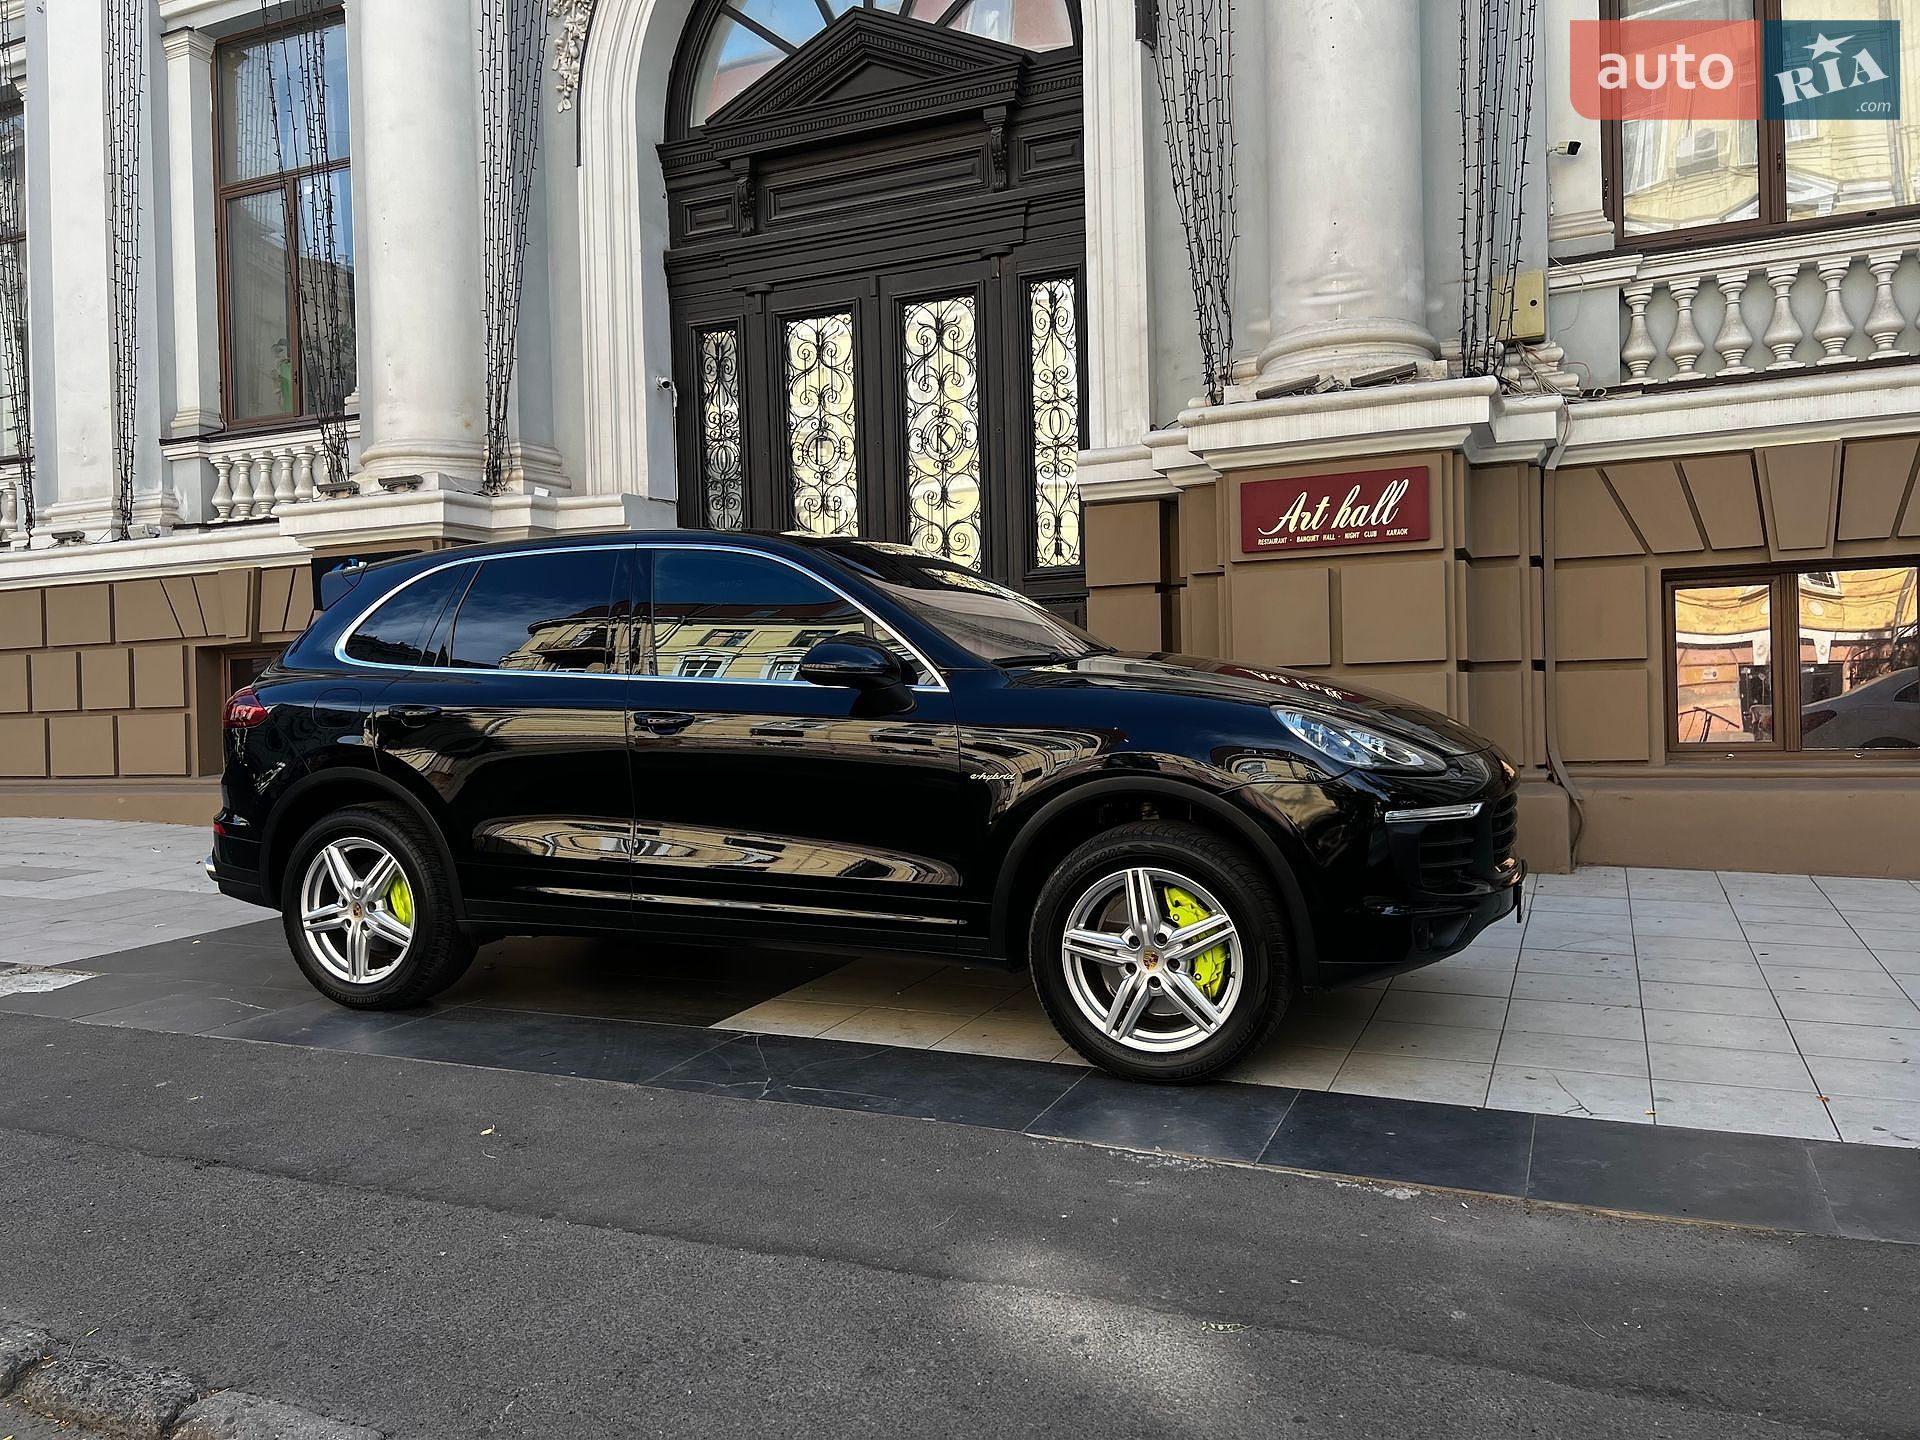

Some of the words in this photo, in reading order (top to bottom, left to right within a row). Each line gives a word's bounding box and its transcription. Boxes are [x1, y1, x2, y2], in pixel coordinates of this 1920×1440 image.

[1258, 491, 1330, 535] Art
[1331, 478, 1409, 529] hall
[1258, 537, 1288, 545] RESTAURANT
[1297, 534, 1320, 542] BANQUET
[1323, 533, 1336, 541] HALL
[1344, 531, 1361, 539] NIGHT
[1363, 530, 1378, 538] CLUB
